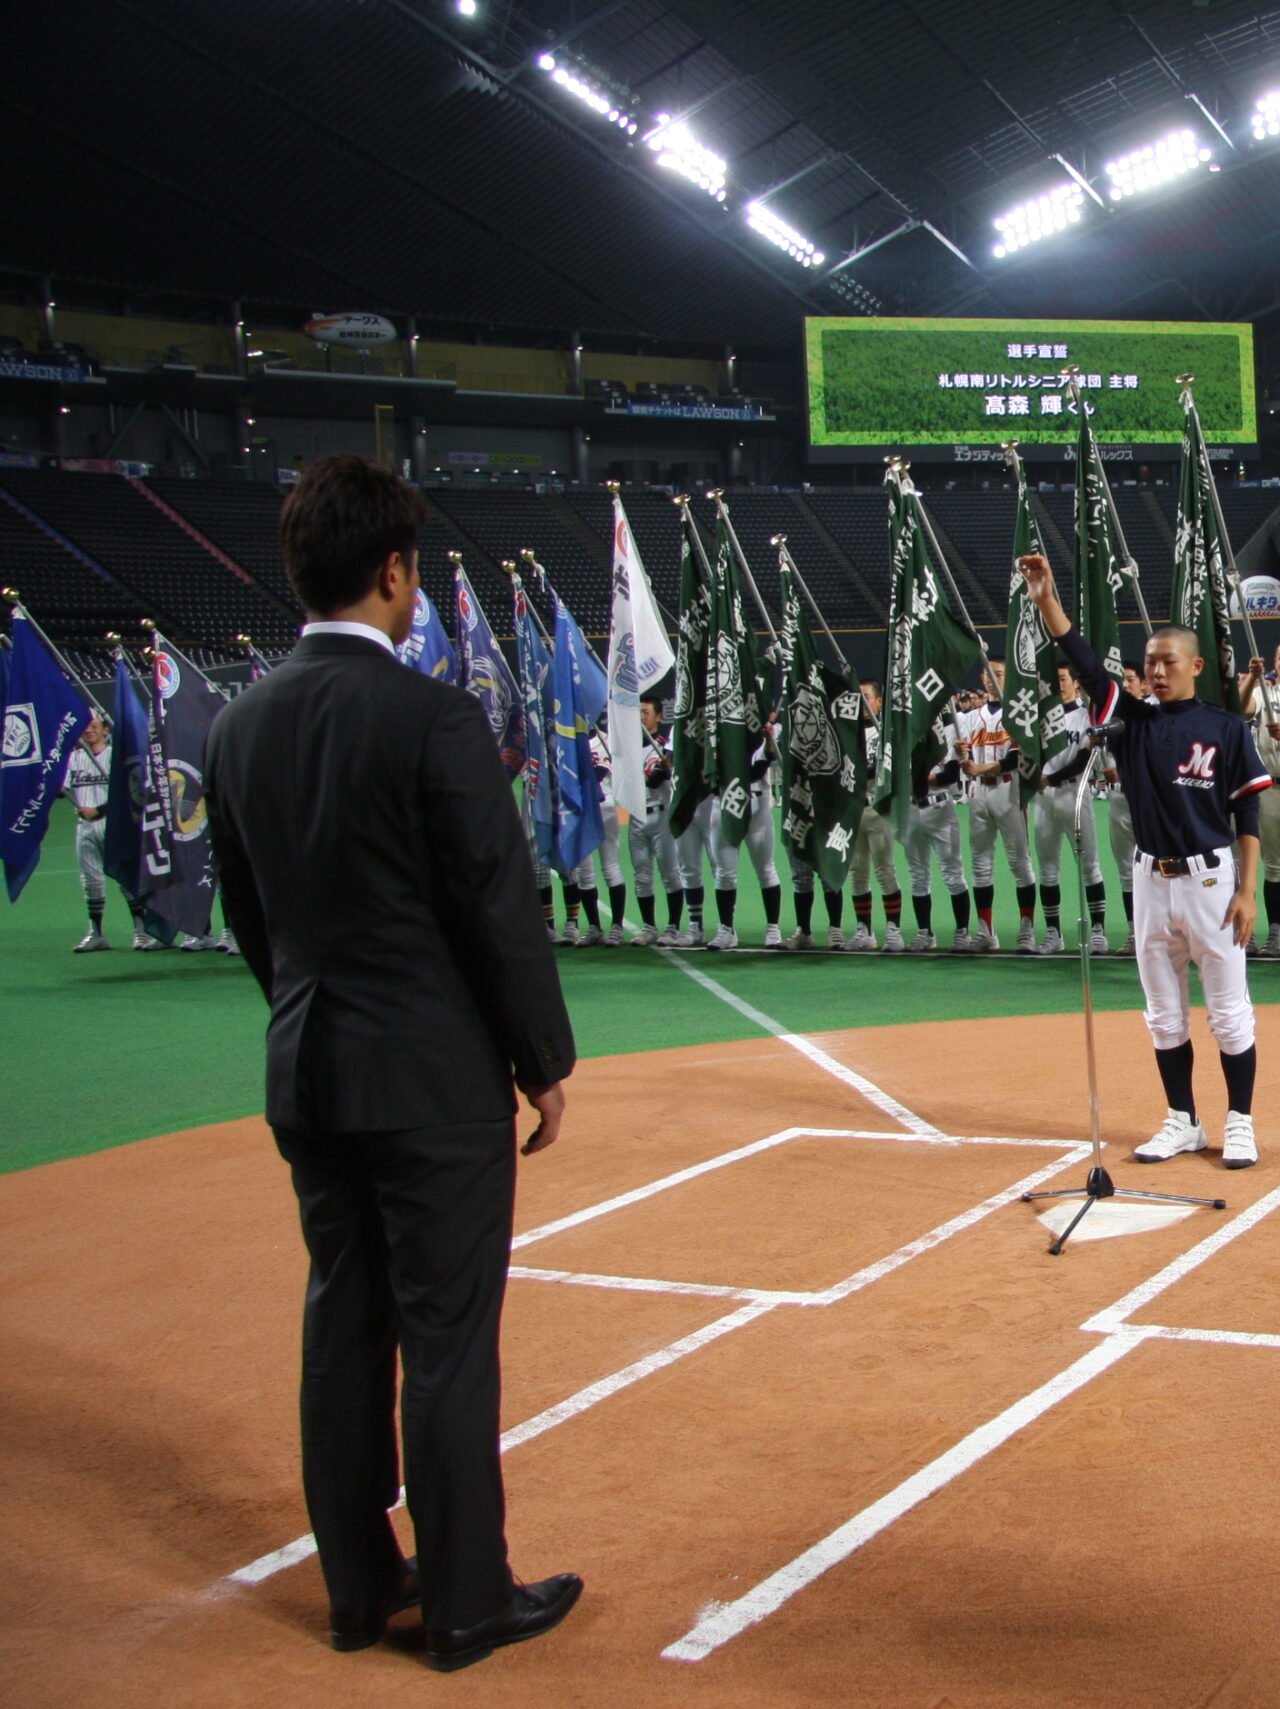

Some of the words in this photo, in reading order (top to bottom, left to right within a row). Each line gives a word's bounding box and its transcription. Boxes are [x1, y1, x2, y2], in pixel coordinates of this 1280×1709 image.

[1007, 344, 1067, 358] 選手宣誓
[1109, 374, 1139, 389] 主将
[683, 407, 740, 419] LAWSON
[1238, 596, 1278, 610] ルキタ
[1177, 741, 1217, 778] M
